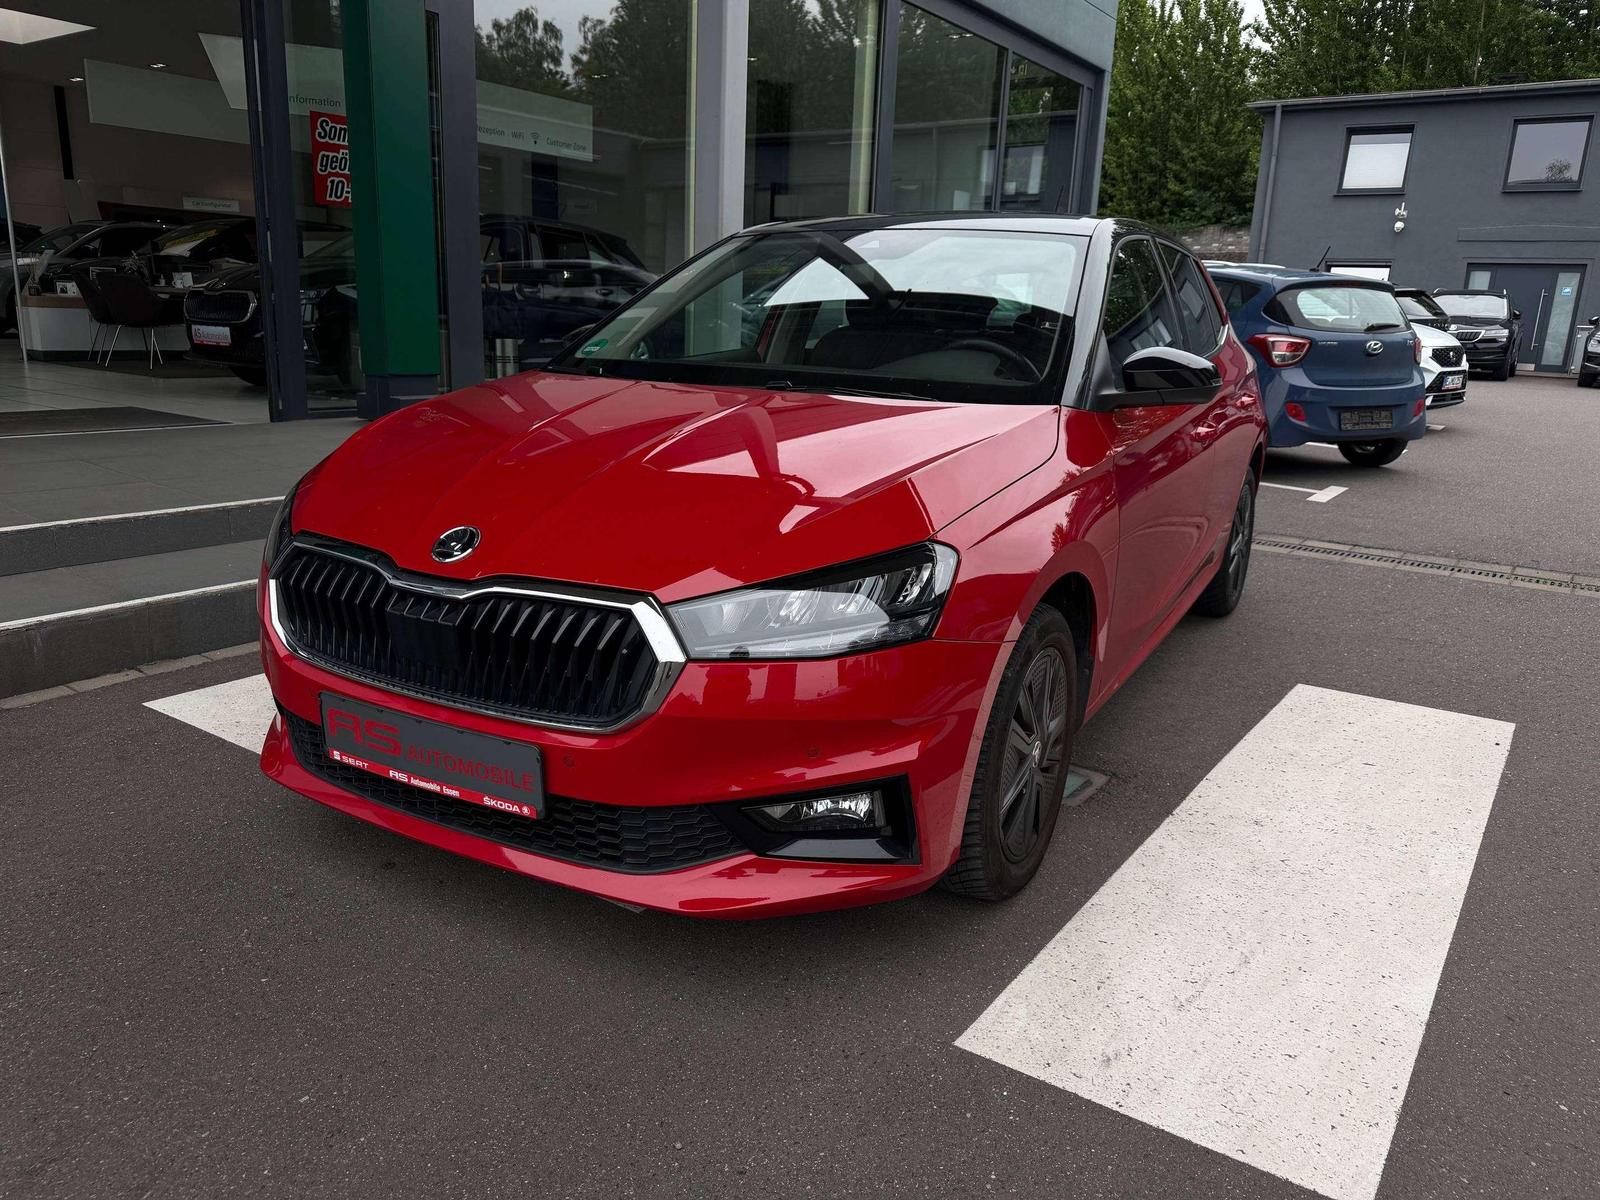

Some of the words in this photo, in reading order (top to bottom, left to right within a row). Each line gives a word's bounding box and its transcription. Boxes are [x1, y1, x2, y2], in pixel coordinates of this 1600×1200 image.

[288, 94, 341, 107] nformation
[317, 149, 350, 175] geö
[326, 176, 352, 203] 10-
[341, 755, 369, 769] SEAT
[407, 745, 534, 793] AUTOMOBILE
[410, 777, 441, 792] Automobile
[443, 785, 460, 798] Essen
[483, 796, 521, 813] ŠKODA
